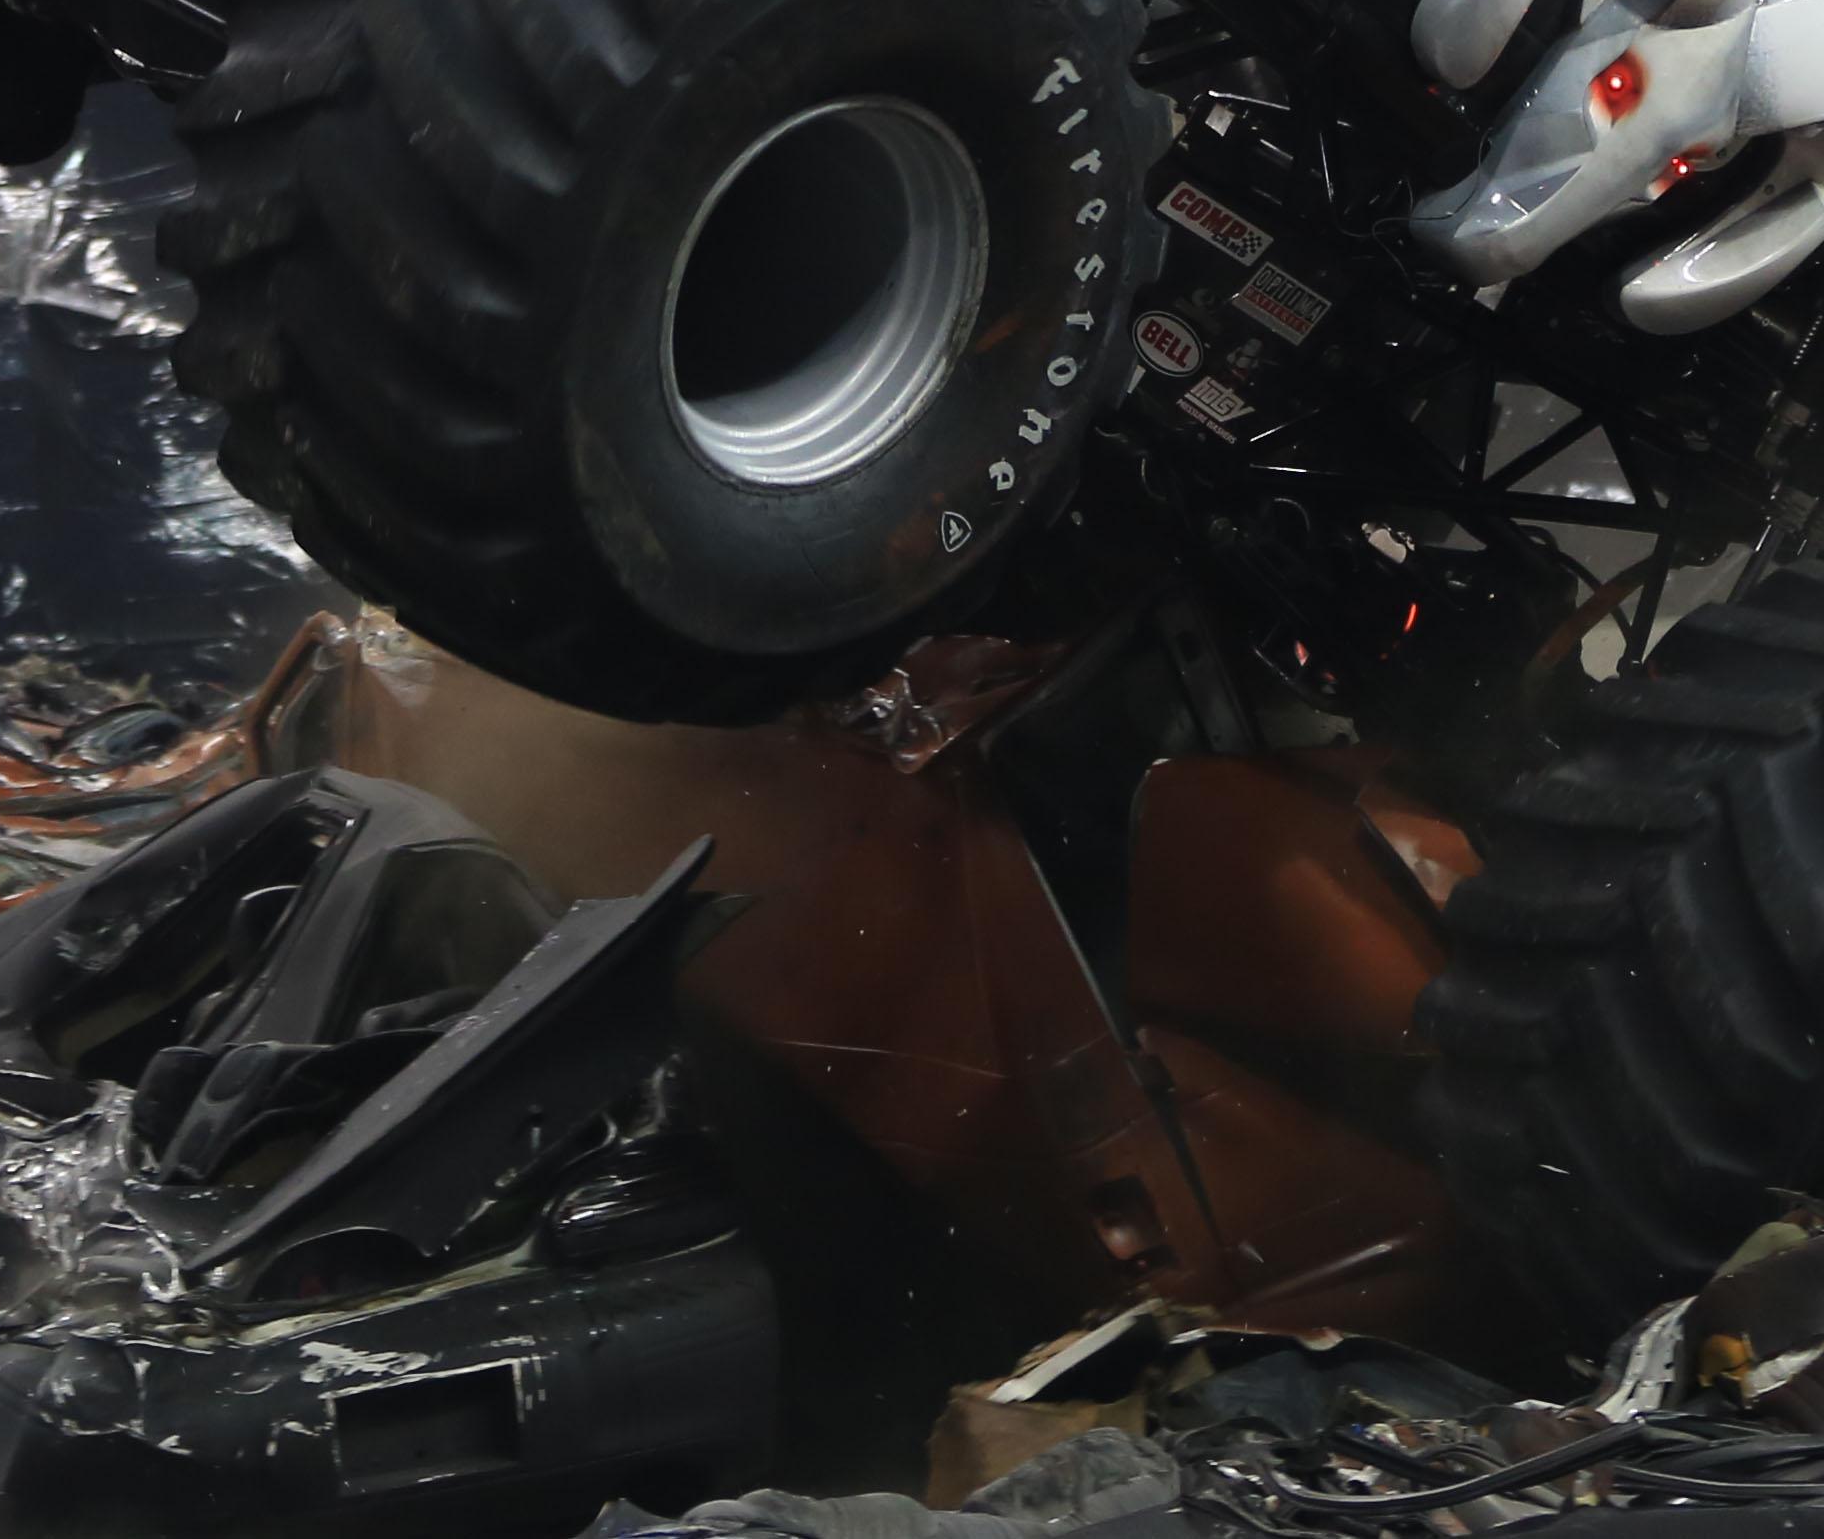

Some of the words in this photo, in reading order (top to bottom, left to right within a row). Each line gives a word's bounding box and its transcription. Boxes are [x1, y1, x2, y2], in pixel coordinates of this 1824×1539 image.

[1169, 188, 1247, 240] COMP
[1254, 267, 1328, 323] OPTIMA
[1140, 318, 1193, 369] BELL
